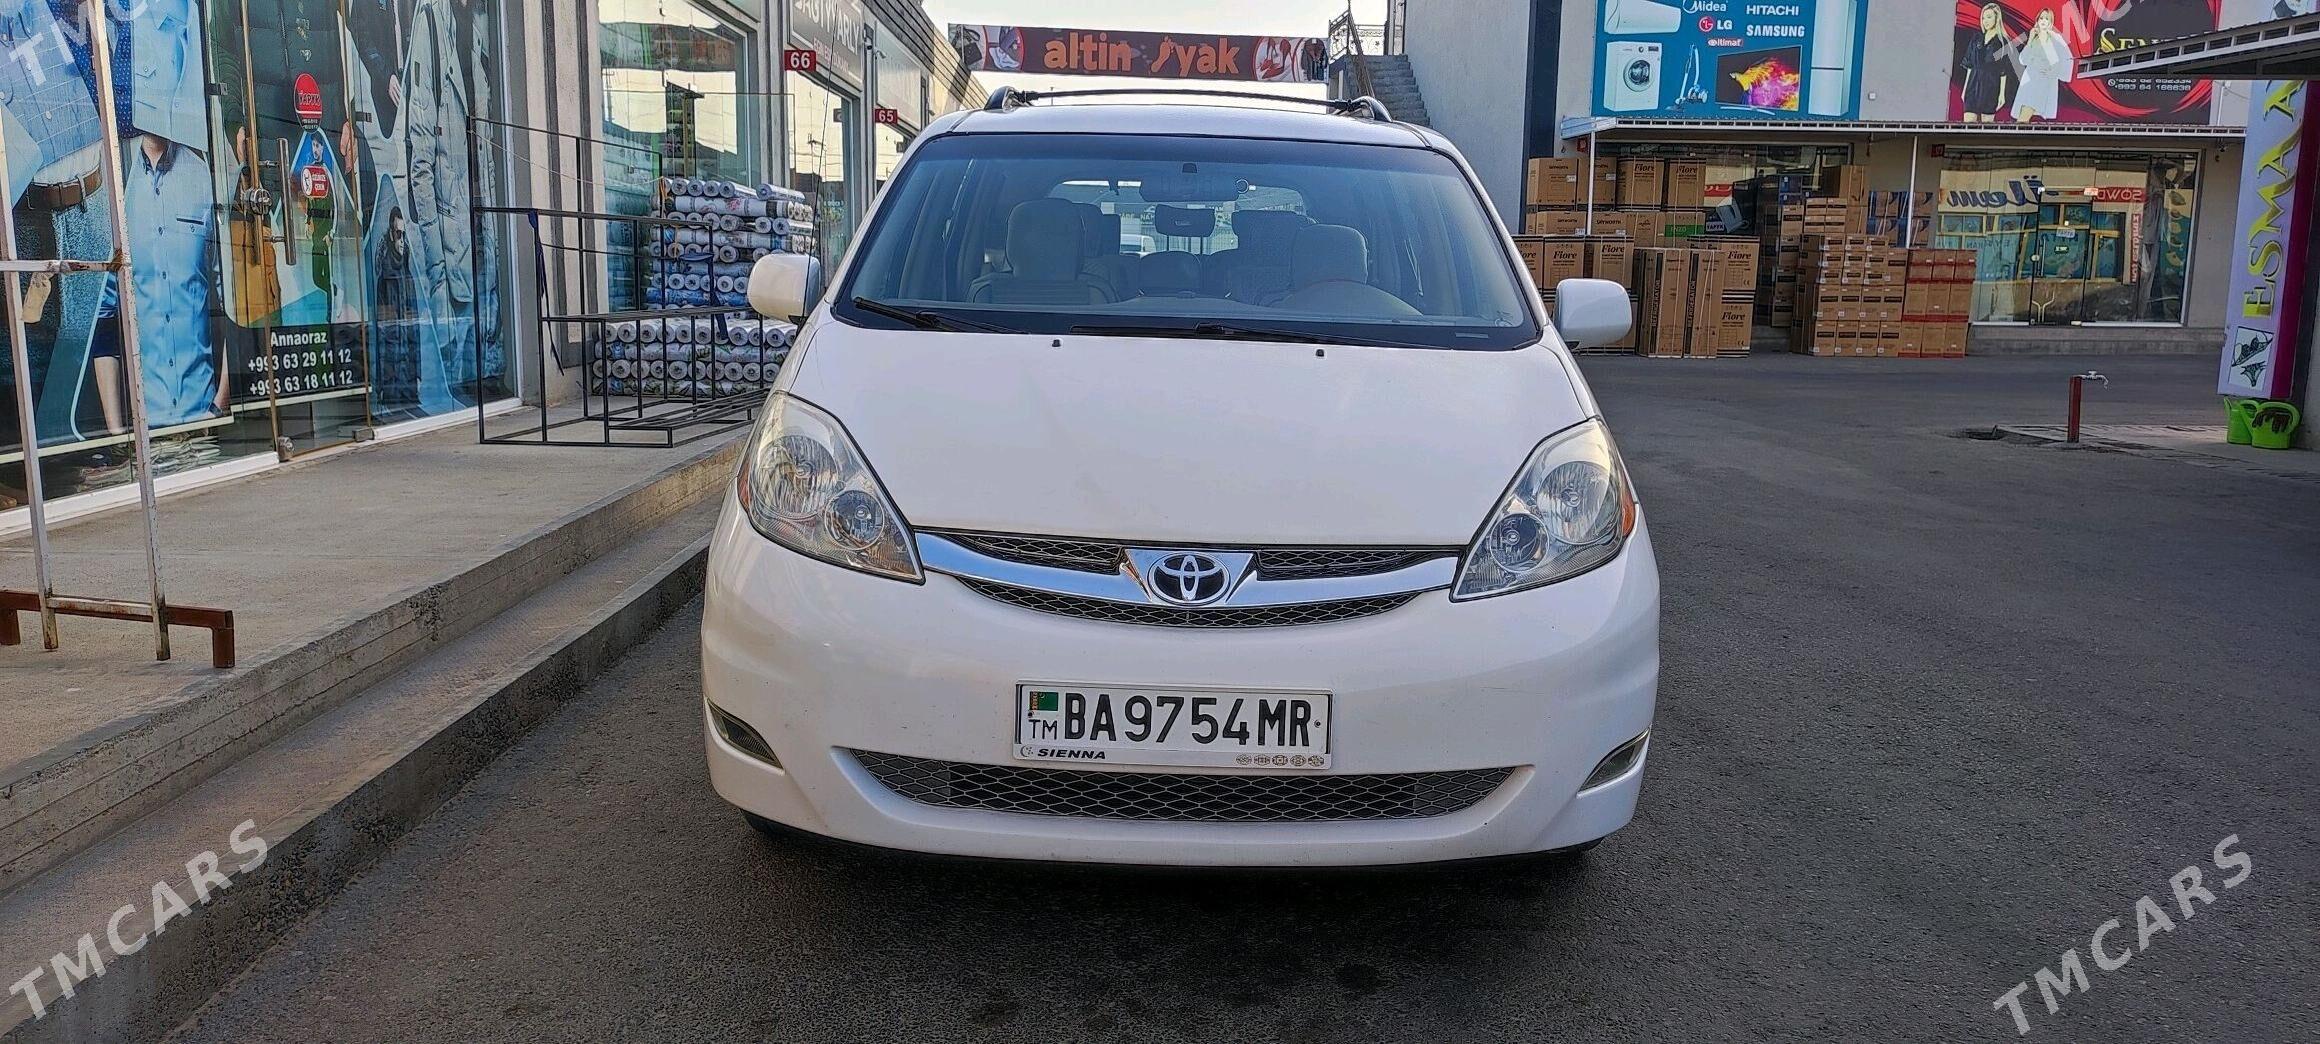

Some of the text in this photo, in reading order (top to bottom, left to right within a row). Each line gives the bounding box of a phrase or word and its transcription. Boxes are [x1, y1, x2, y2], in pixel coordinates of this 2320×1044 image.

[1683, 0, 1727, 13] Midea
[1746, 5, 1799, 16] HITACHI
[1717, 20, 1732, 30] LG
[1746, 24, 1805, 37] SAMSUNG
[1044, 32, 1131, 71] altin
[790, 52, 810, 68] 66
[878, 110, 894, 122] 65
[1553, 250, 1578, 259] Fiore
[1601, 244, 1625, 253] Fiore
[1727, 250, 1752, 260] Fiore
[1721, 311, 1746, 321] Fiore
[270, 331, 328, 347] Annaoraz
[282, 353, 299, 370] 63
[302, 351, 317, 368] 29
[320, 349, 334, 365] 11
[338, 348, 352, 364] 12
[284, 375, 300, 392] 63
[303, 373, 319, 390] 18
[322, 371, 336, 388] 11
[339, 369, 353, 385] 12
[1028, 718, 1058, 740] TM
[1037, 747, 1106, 760] SIENNA
